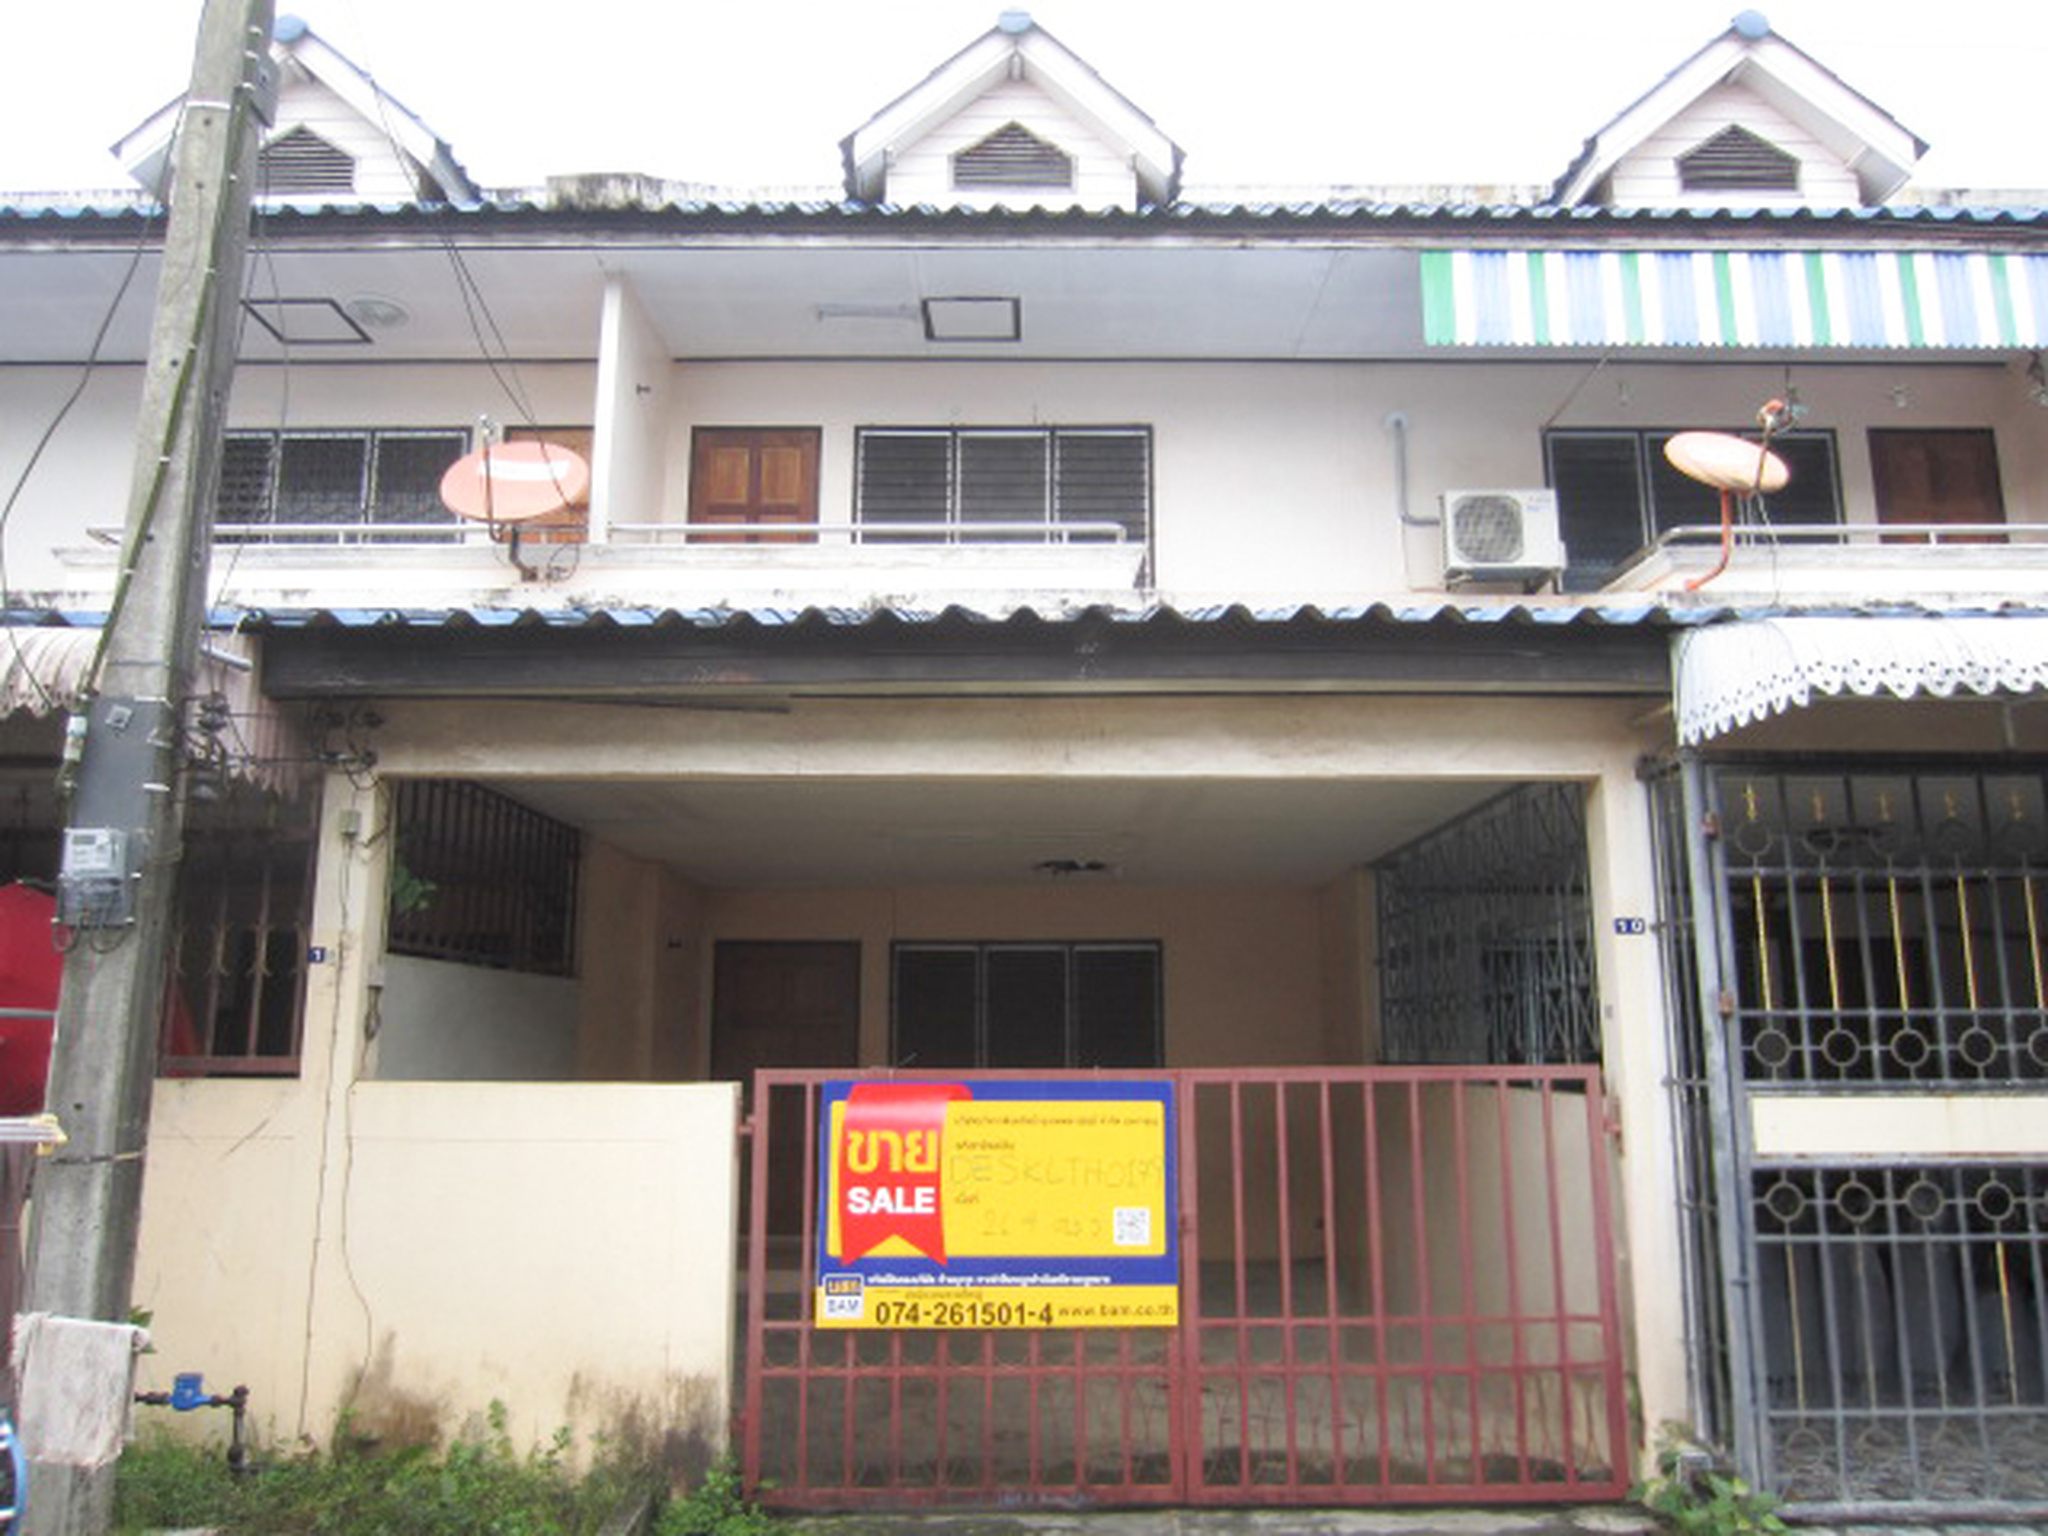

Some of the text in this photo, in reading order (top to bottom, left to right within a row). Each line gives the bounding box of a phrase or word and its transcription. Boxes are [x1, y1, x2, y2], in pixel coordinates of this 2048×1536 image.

[848, 1130, 937, 1172] ขาย
[847, 1186, 936, 1214] SALE
[828, 1299, 860, 1313] BAM
[875, 1301, 1053, 1326] 074-261501-4
